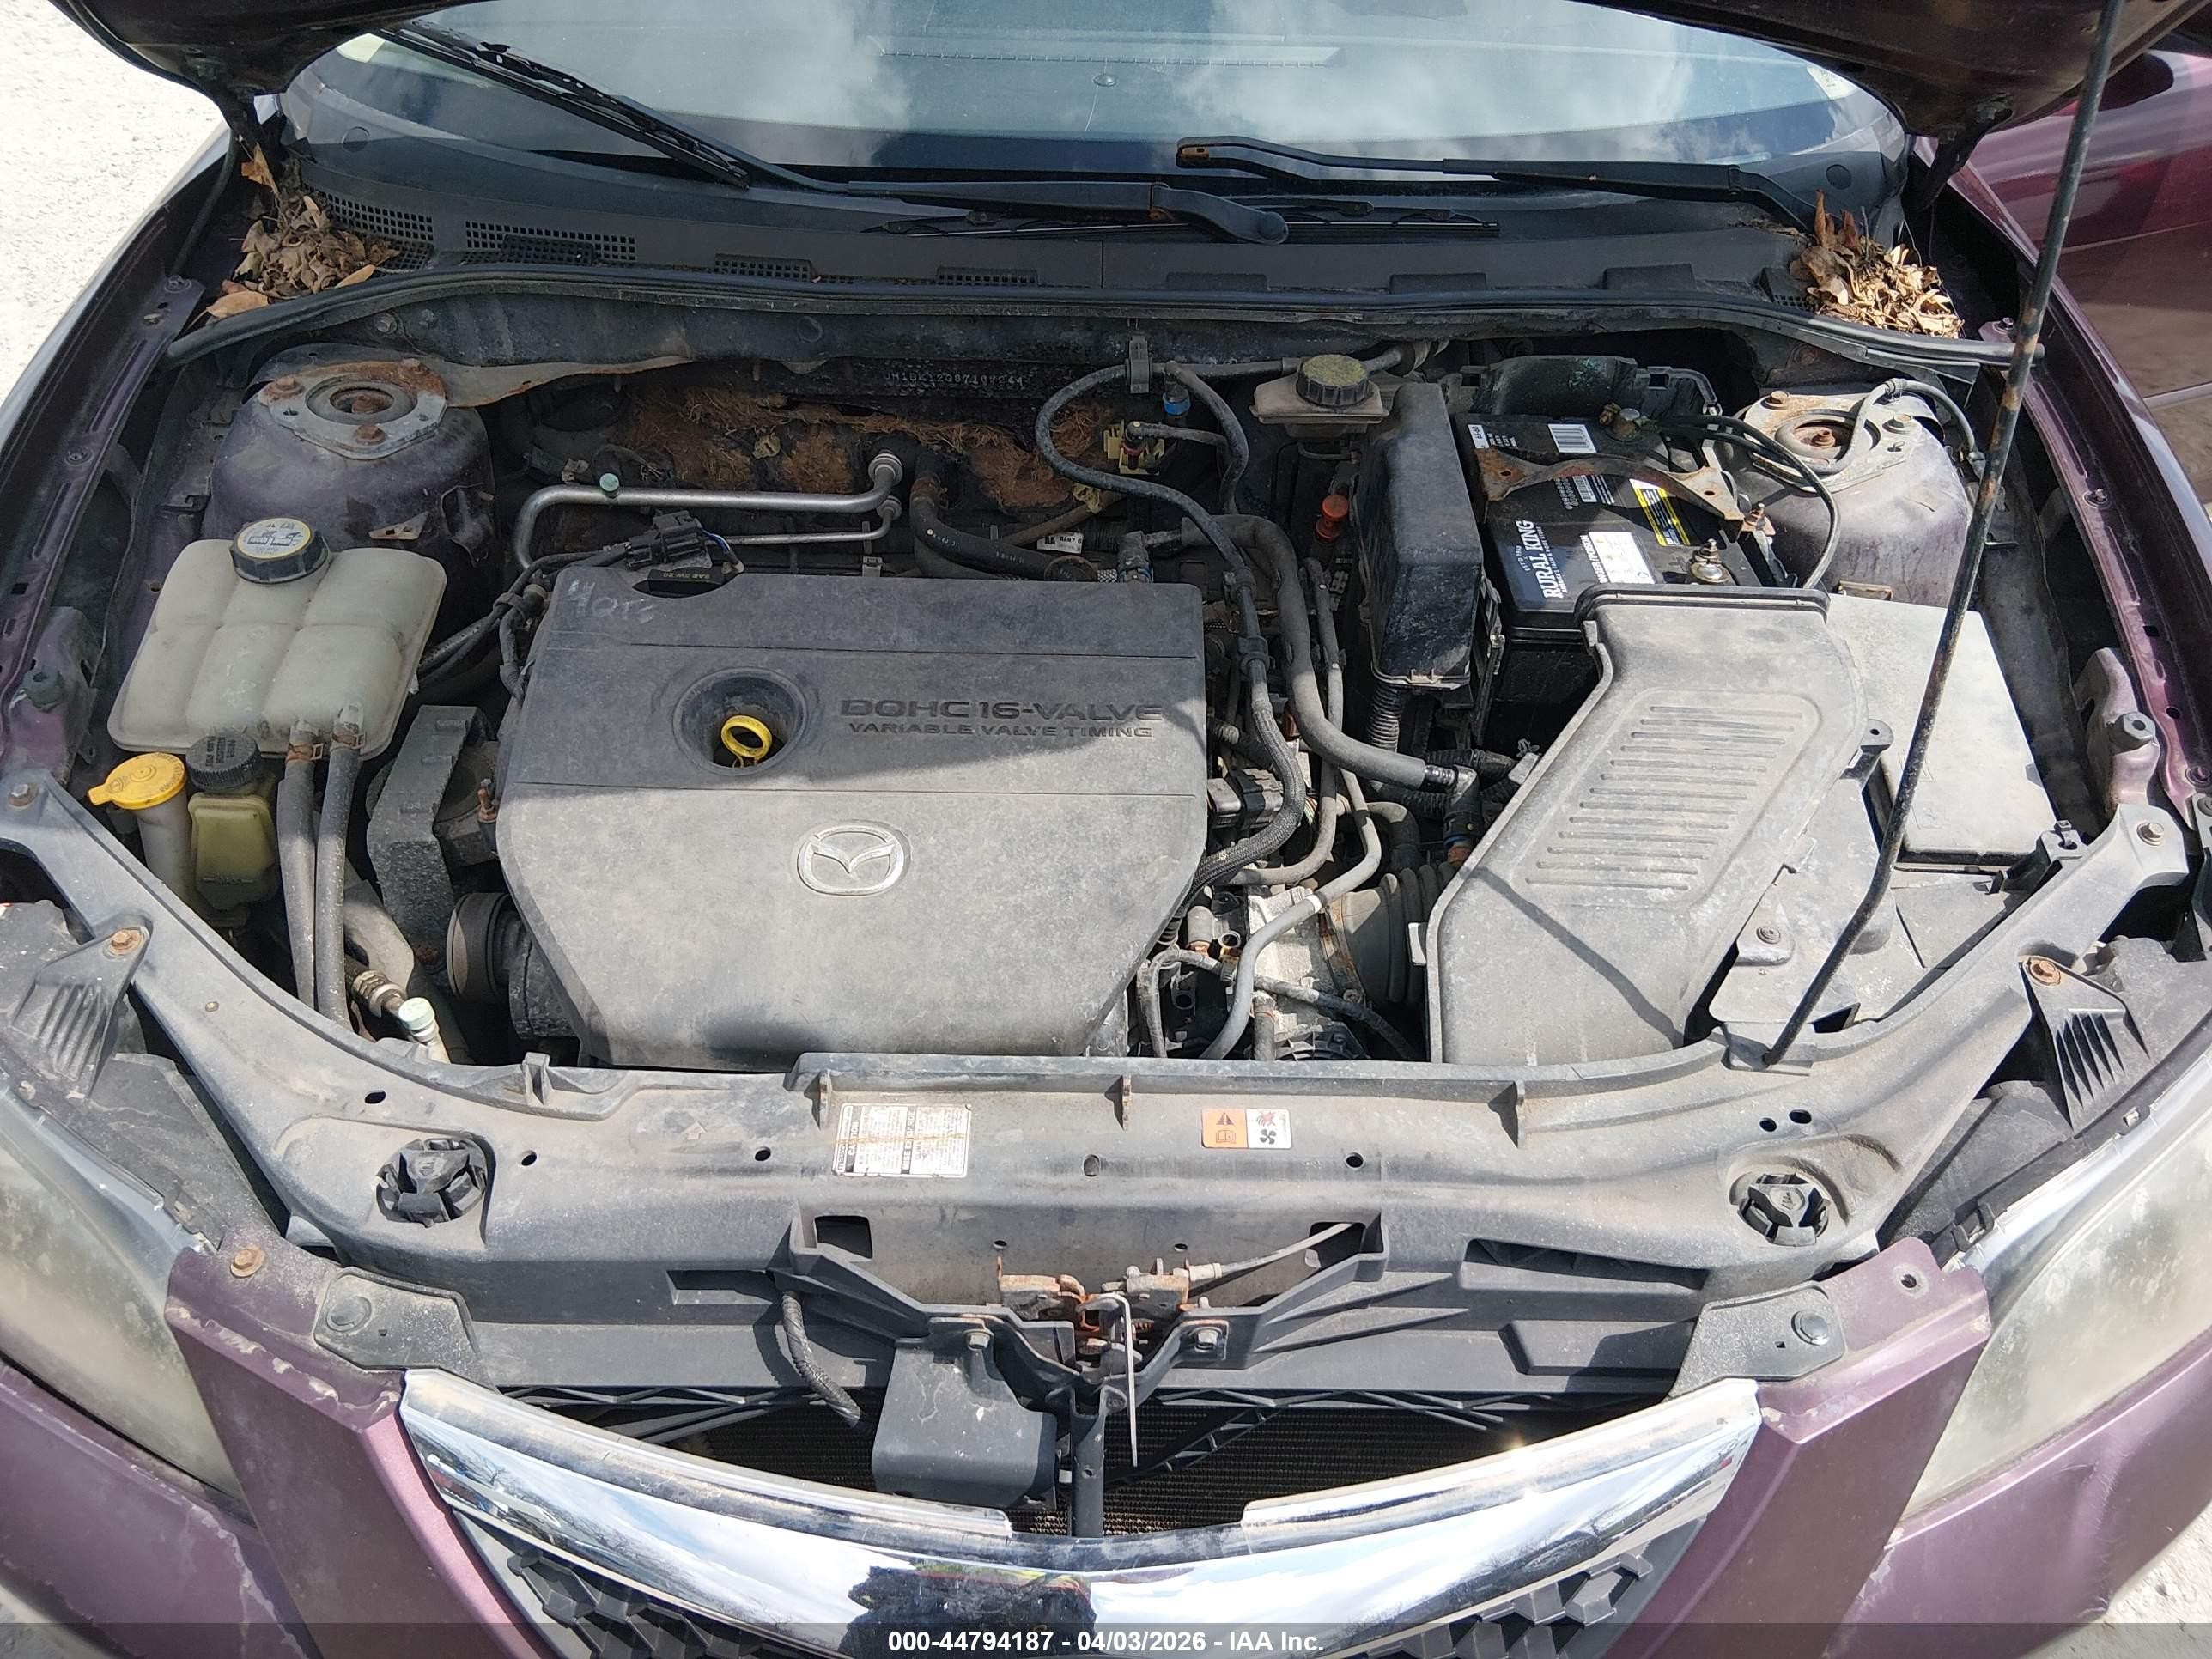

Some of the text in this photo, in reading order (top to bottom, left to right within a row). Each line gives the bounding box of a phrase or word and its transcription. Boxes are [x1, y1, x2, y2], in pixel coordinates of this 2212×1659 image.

[1515, 520, 1564, 599] RURAL KING
[841, 699, 1163, 721] DOHC 16-VALVE
[848, 722, 1153, 738] VARIABLE VALVE TIMING
